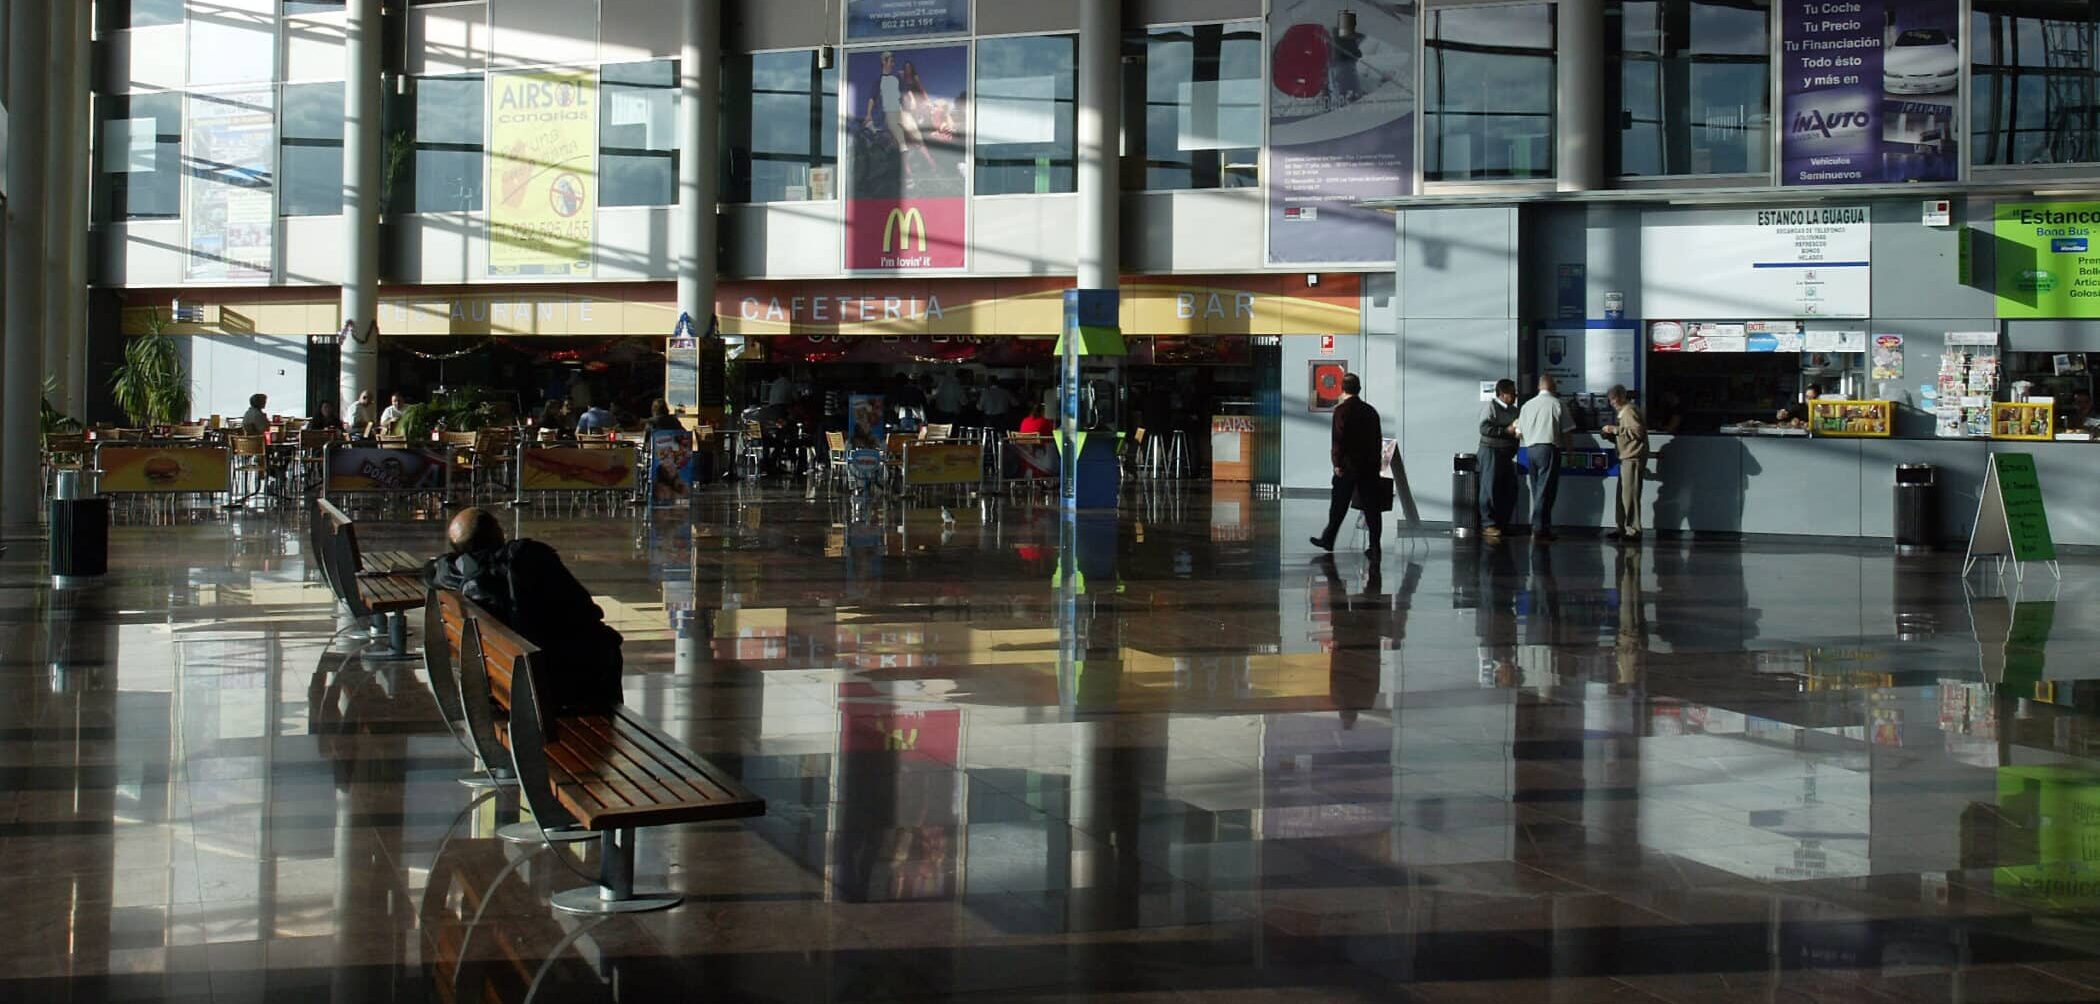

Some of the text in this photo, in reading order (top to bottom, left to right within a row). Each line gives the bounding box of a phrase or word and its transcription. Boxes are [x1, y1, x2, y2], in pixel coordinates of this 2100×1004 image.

[1803, 2, 1861, 14] Tu Coche
[1803, 20, 1861, 32] Tu Precio
[1784, 37, 1880, 51] Tu Financiación
[1801, 55, 1862, 68] Todo ésto
[1803, 75, 1859, 88] y más en
[498, 109, 588, 124] canarias
[1799, 170, 1862, 181] Seminuevos
[1758, 208, 1865, 226] ESTANCO LA GUAGUA
[2036, 227, 2065, 237] Bono
[2068, 226, 2090, 236] Bus
[740, 295, 944, 321] CAFETERIA
[1176, 291, 1255, 319] BAR
[1215, 416, 1255, 433] TAPAS
